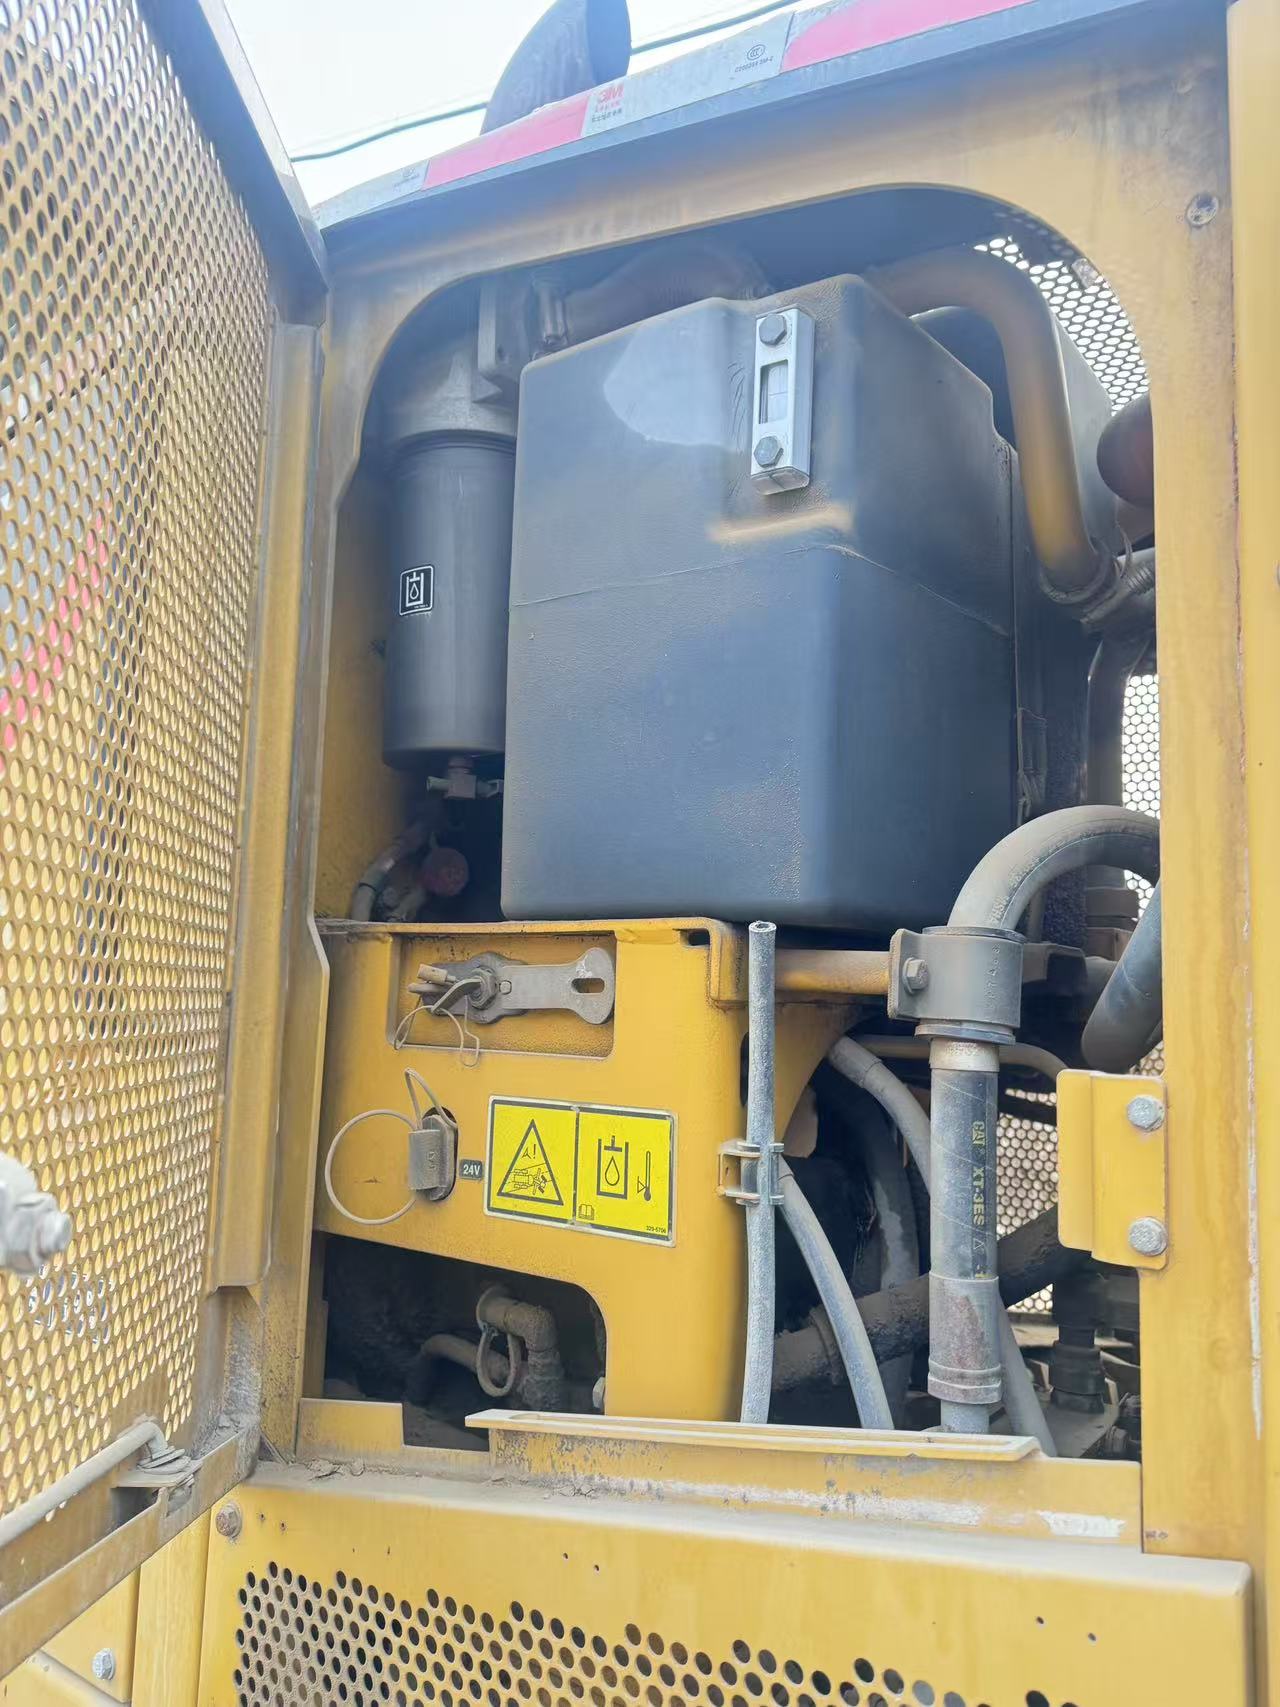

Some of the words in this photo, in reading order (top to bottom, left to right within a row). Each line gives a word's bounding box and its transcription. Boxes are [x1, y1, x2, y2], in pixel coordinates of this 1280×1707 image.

[972, 1120, 985, 1145] CAT
[463, 1163, 481, 1175] 24V
[973, 1166, 985, 1226] XT-3ES
